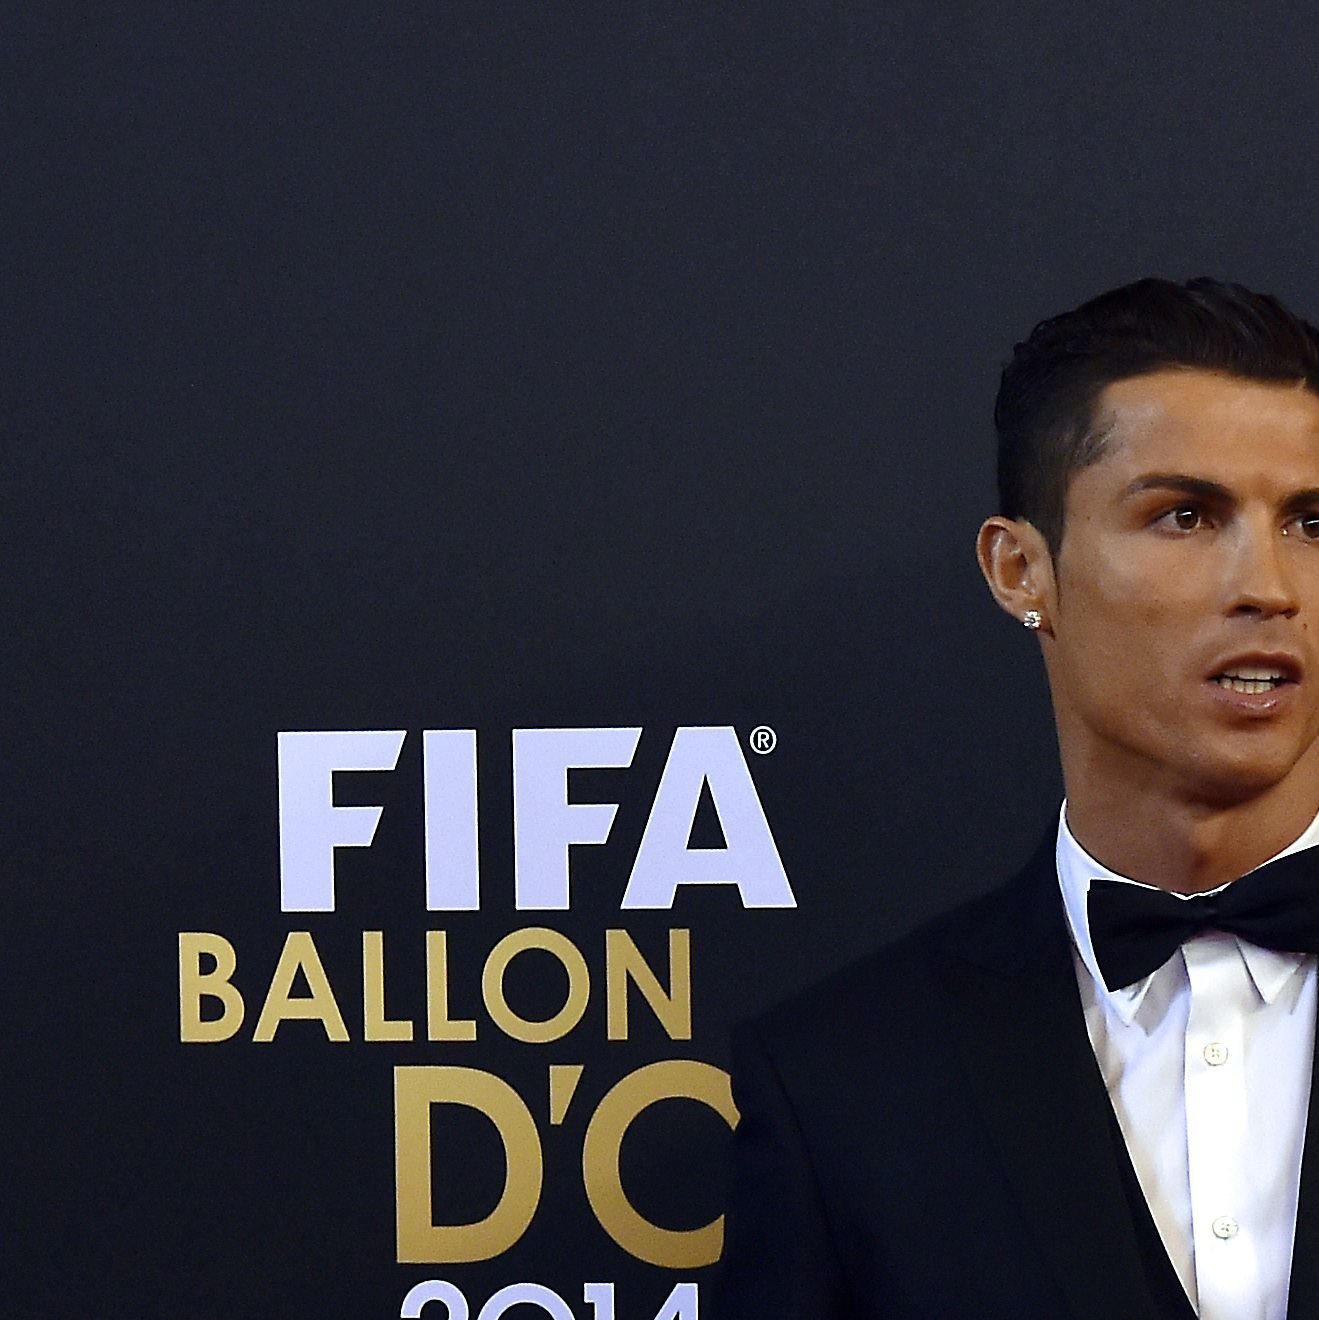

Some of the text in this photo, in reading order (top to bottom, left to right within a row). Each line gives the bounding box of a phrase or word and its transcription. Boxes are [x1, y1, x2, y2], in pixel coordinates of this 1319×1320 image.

[276, 726, 798, 912] FIFA
[178, 926, 692, 1044] BALLON
[393, 1059, 742, 1269] D'O
